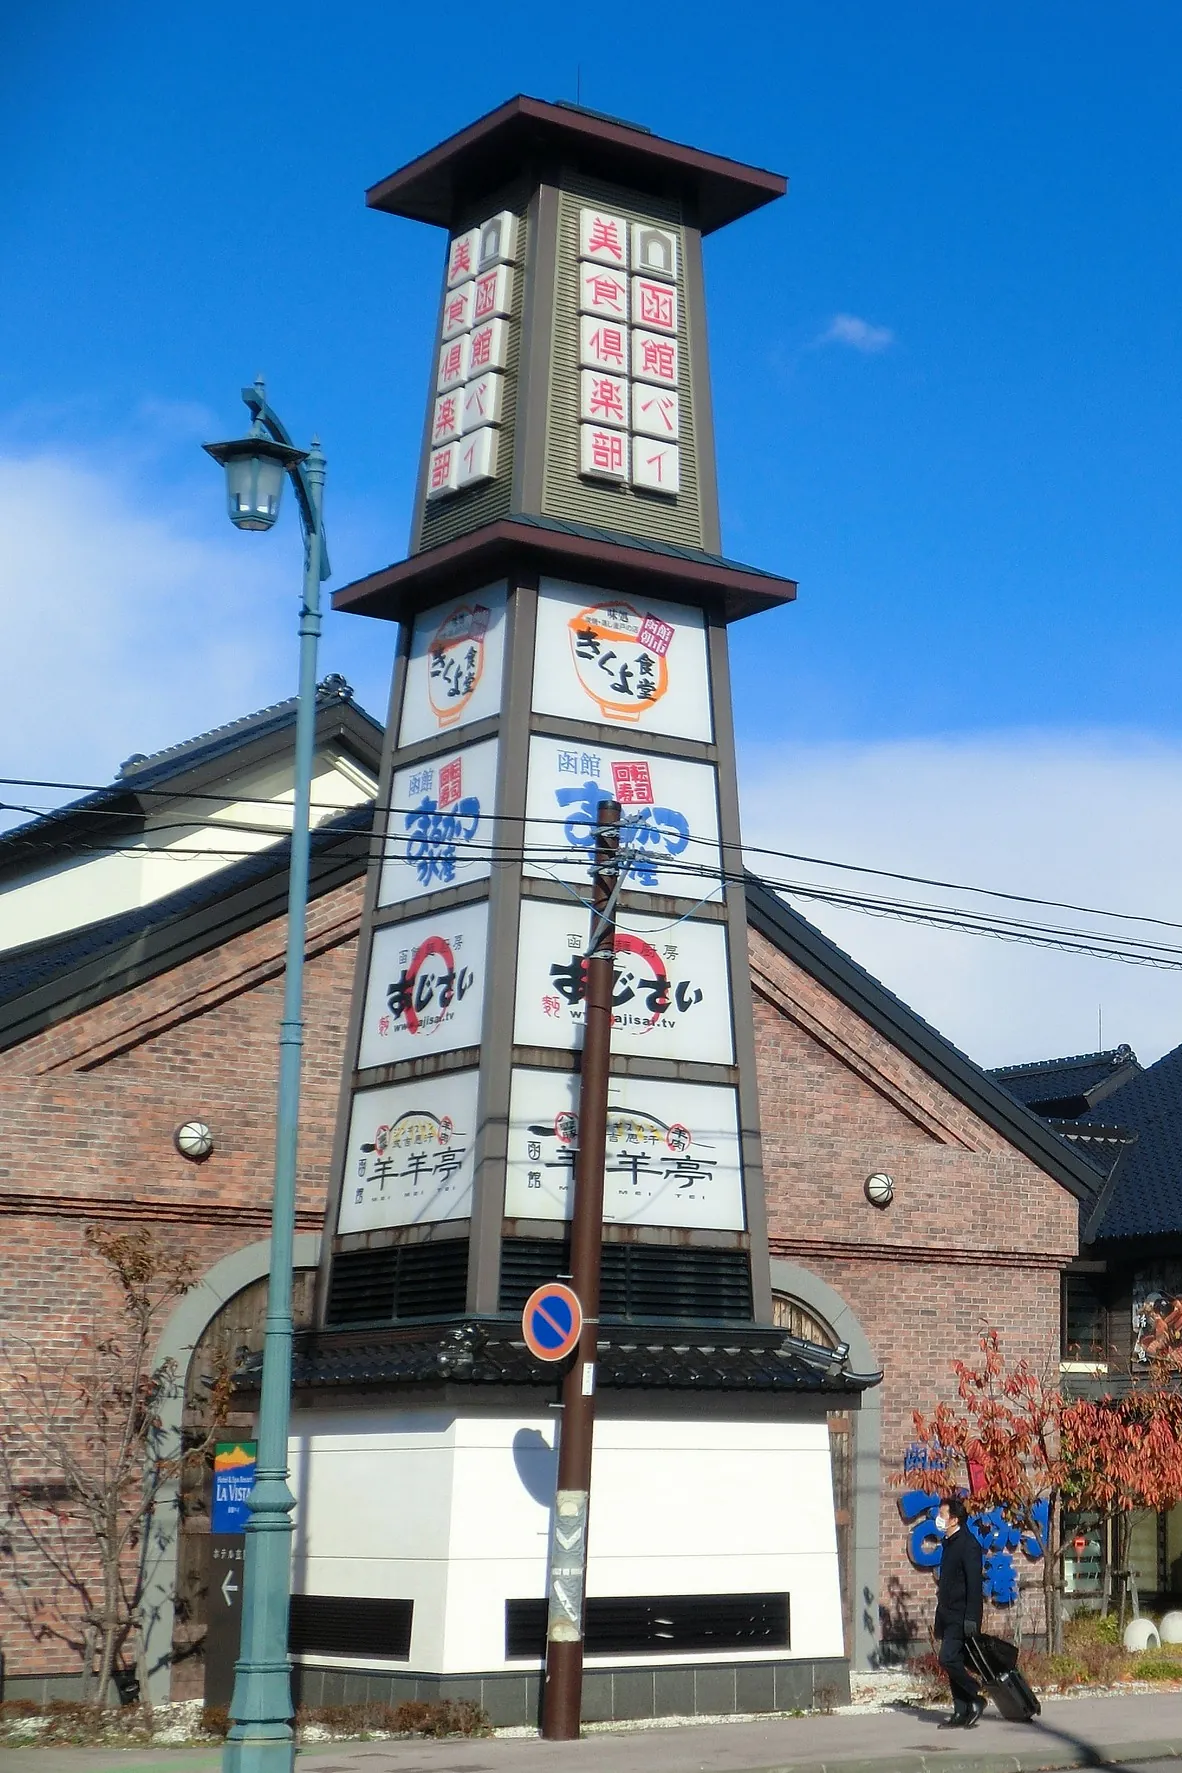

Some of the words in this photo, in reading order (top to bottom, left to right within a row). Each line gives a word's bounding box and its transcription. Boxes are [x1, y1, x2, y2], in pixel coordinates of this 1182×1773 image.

[431, 237, 471, 489] 美食倶楽部
[463, 270, 497, 474] 函館ベイ
[586, 216, 626, 472] 美食倶楽部
[639, 282, 676, 482] 函館ベイ
[408, 768, 434, 797] 函館
[556, 749, 601, 778] 函館
[607, 1132, 659, 1146] 吉思汗
[216, 1484, 228, 1501] LA
